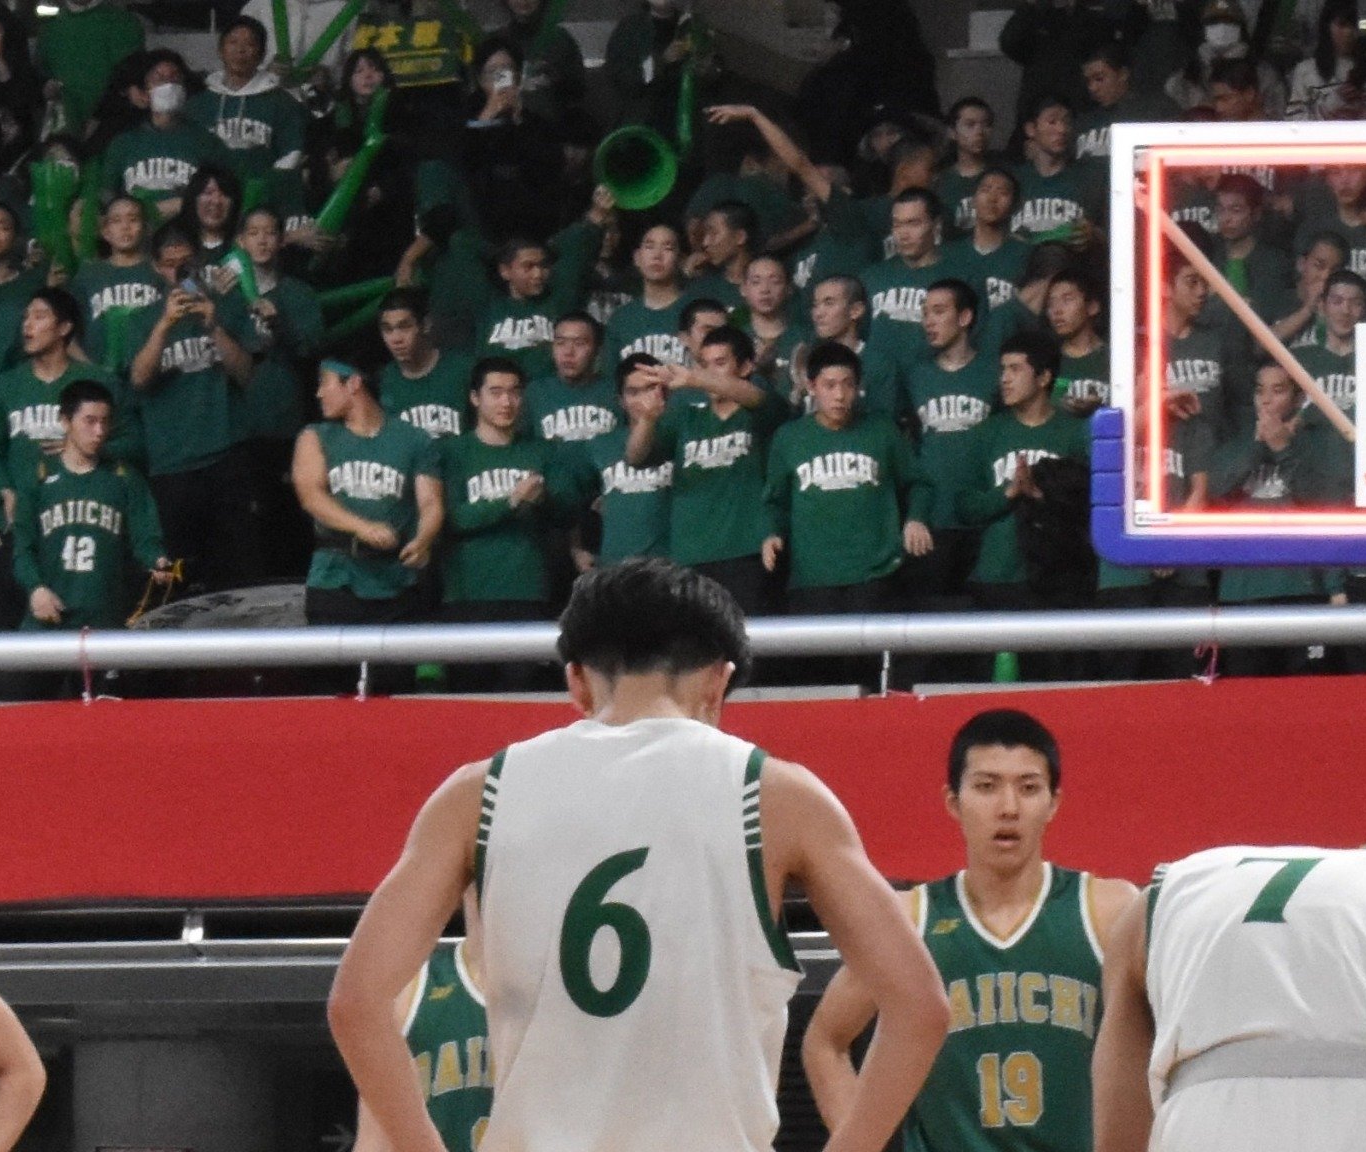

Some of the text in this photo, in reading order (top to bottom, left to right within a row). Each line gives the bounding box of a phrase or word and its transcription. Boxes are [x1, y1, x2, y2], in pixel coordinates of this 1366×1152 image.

[872, 289, 927, 319] DAIIC
[329, 461, 405, 497] DAIICHI
[797, 452, 879, 490] DAIICHI
[40, 501, 122, 536] DAIICHI
[62, 536, 96, 571] 42
[1235, 856, 1326, 924] 7
[559, 846, 653, 1019] 6
[949, 971, 1099, 1040] AIICHI
[975, 1051, 1044, 1129] 19
